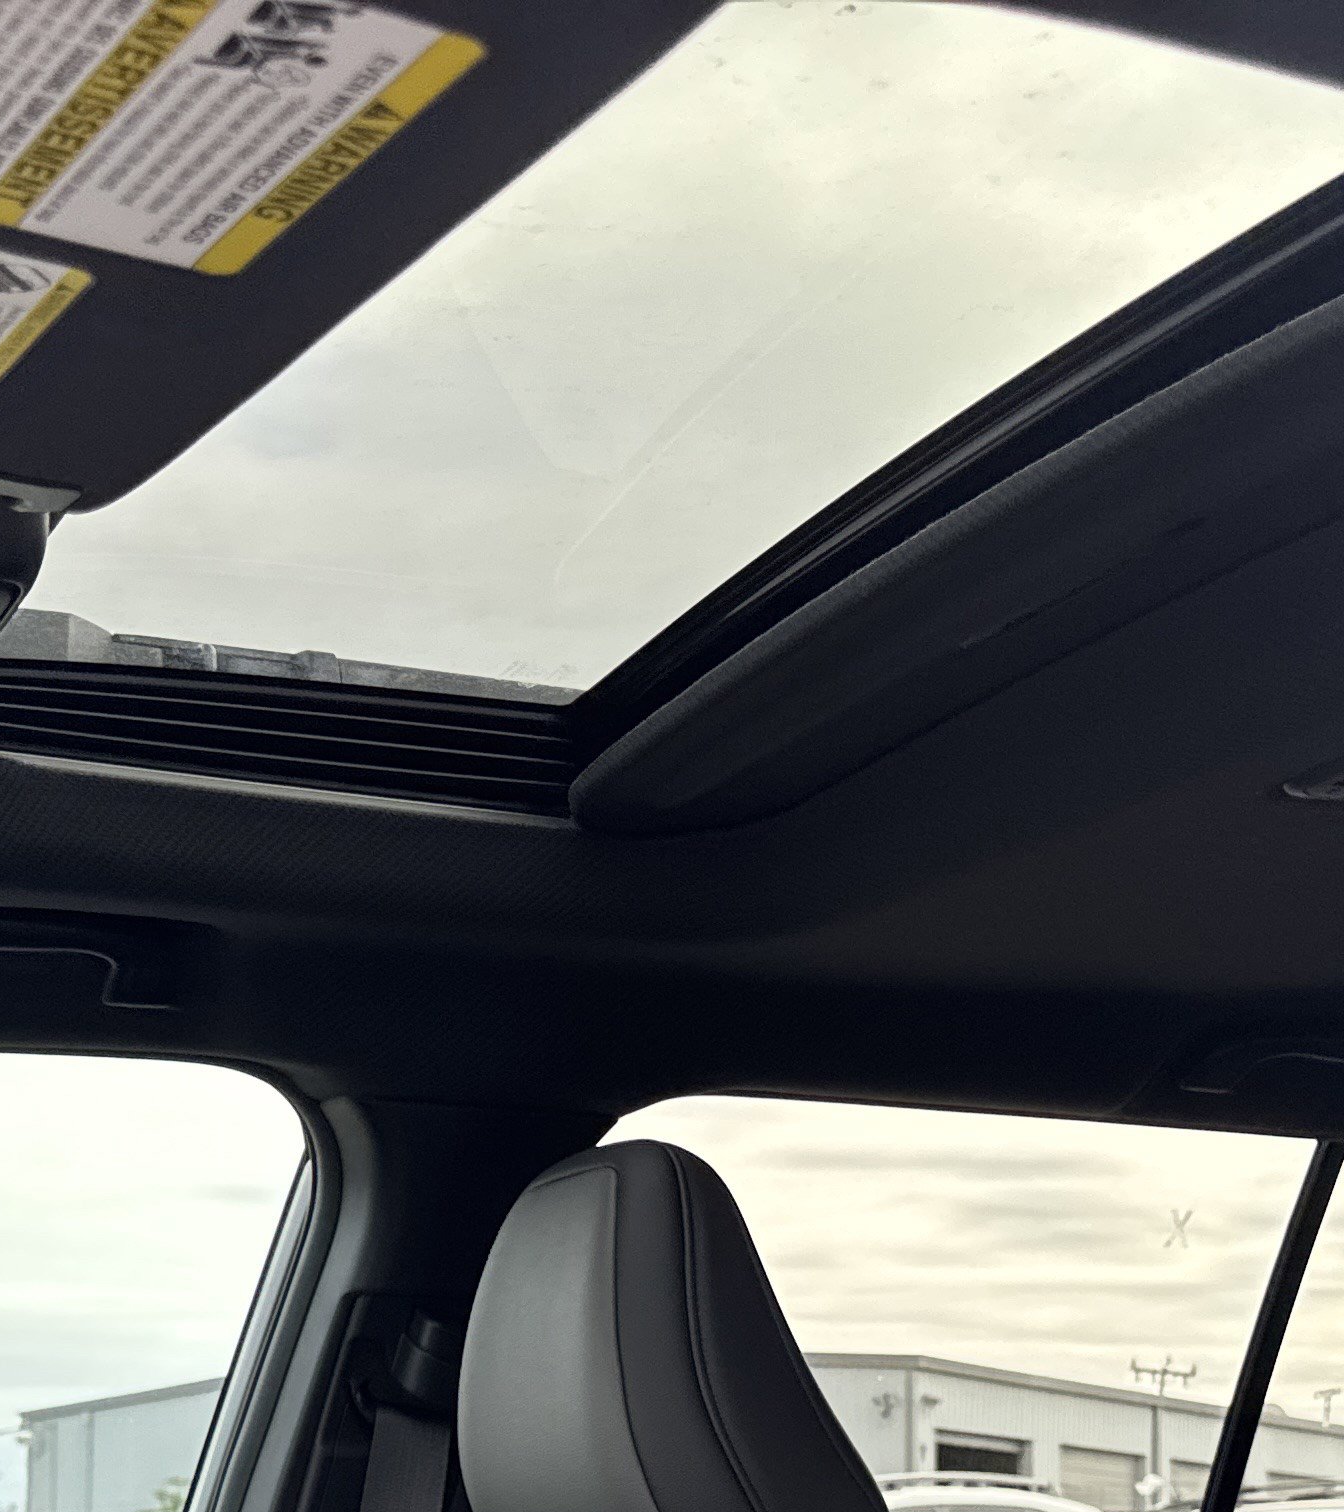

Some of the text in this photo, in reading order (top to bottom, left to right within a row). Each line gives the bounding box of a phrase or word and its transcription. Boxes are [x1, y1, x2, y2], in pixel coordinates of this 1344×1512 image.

[182, 53, 399, 245] EVEN WITH ADVANCED AIR BAGS
[255, 124, 393, 222] WARNING
